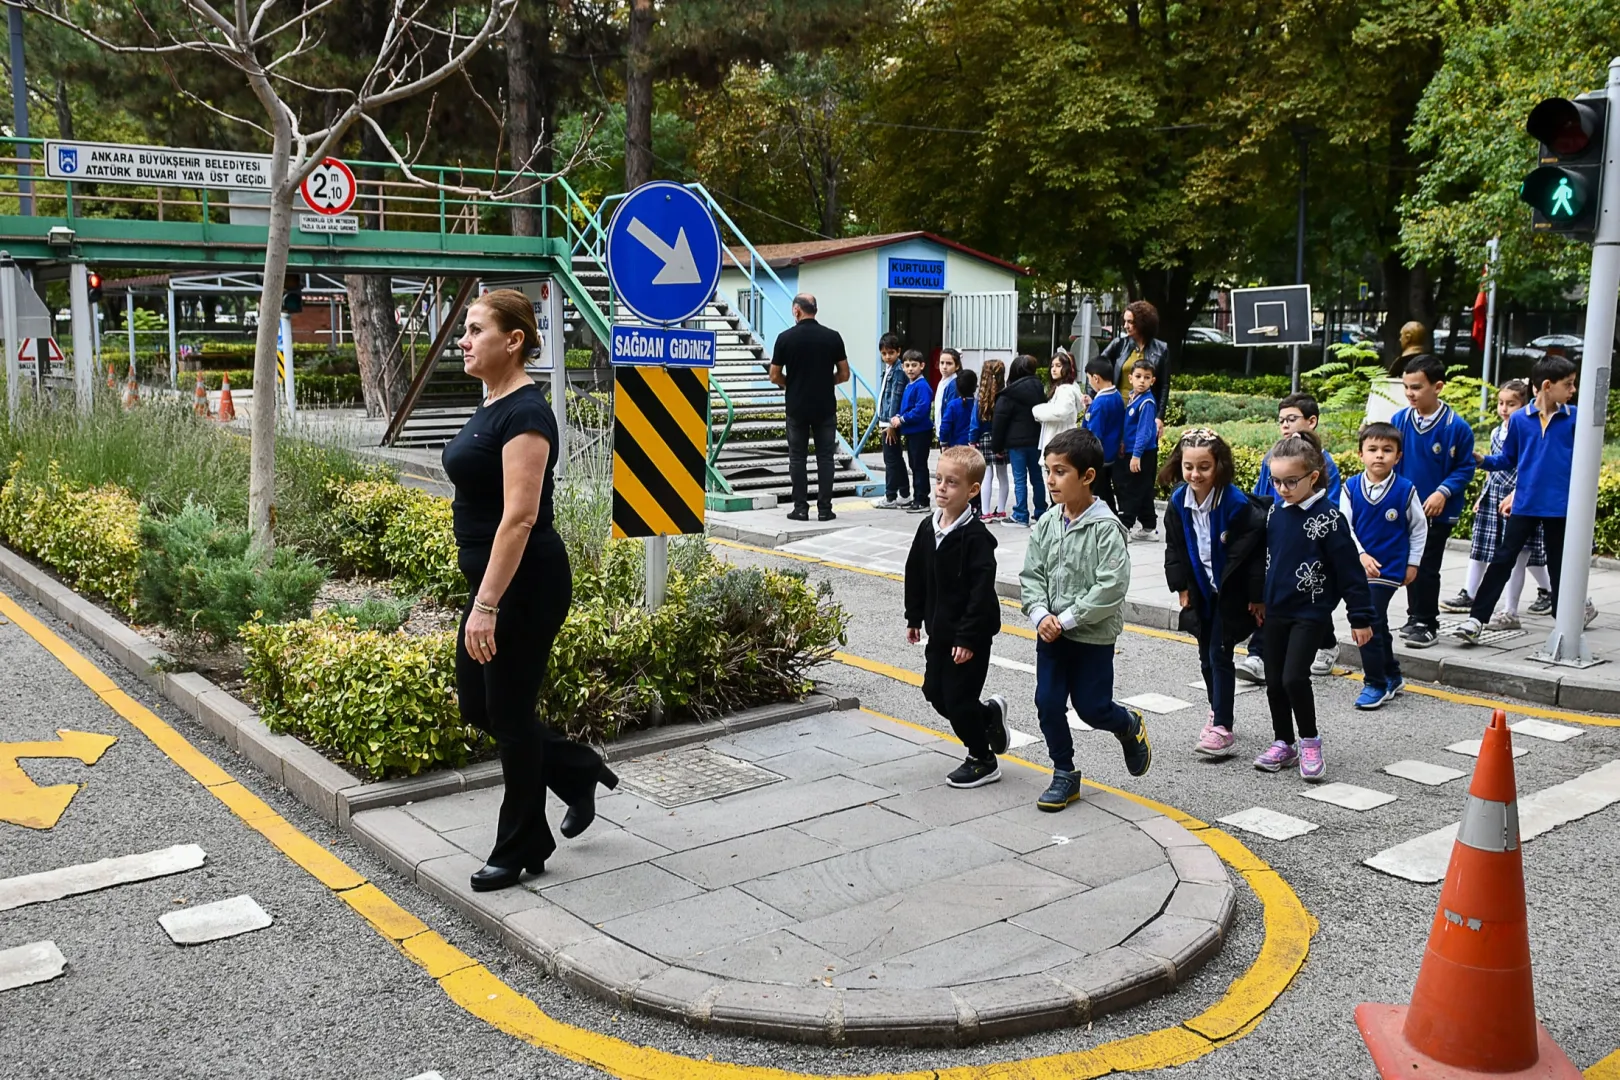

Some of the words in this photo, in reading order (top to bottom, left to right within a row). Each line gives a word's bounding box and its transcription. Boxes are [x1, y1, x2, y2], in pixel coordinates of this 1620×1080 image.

[91, 151, 134, 163] ANKARA
[85, 165, 131, 177] ATATÜRK
[136, 167, 177, 180] BULVARI
[182, 171, 205, 181] YAYA
[210, 171, 229, 183] ÜST
[891, 262, 943, 276] KURTULUŞ
[614, 331, 664, 358] SAĞDAN
